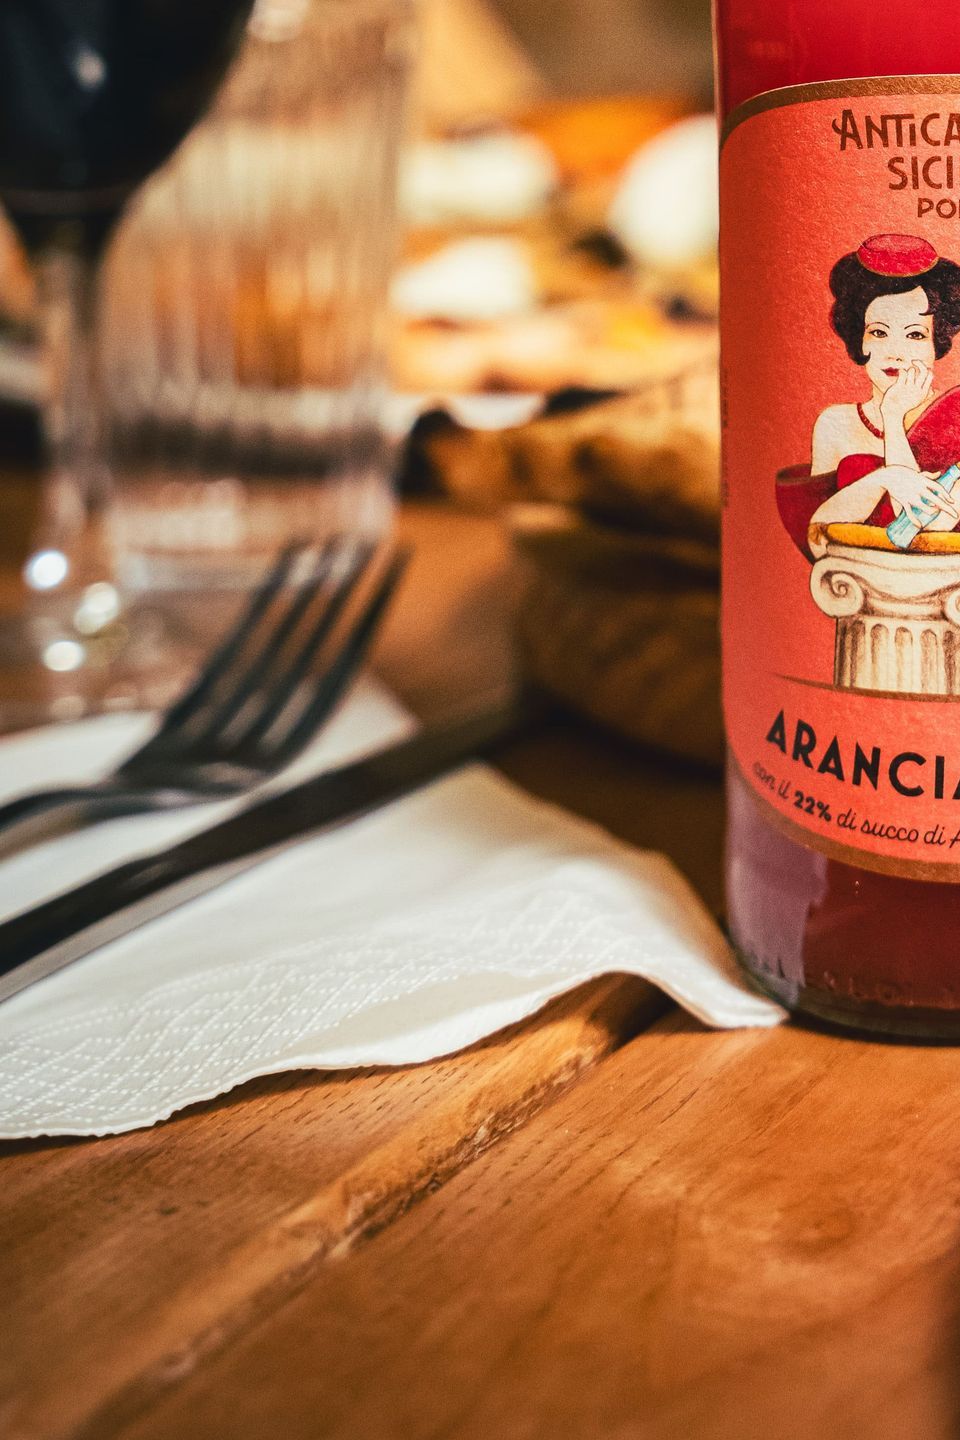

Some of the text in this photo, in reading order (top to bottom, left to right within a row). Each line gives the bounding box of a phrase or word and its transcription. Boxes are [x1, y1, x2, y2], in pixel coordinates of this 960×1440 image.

[778, 779, 792, 800] il
[793, 789, 832, 823] 22%
[836, 807, 858, 831] di
[860, 819, 919, 843] succo
[923, 823, 947, 846] di
